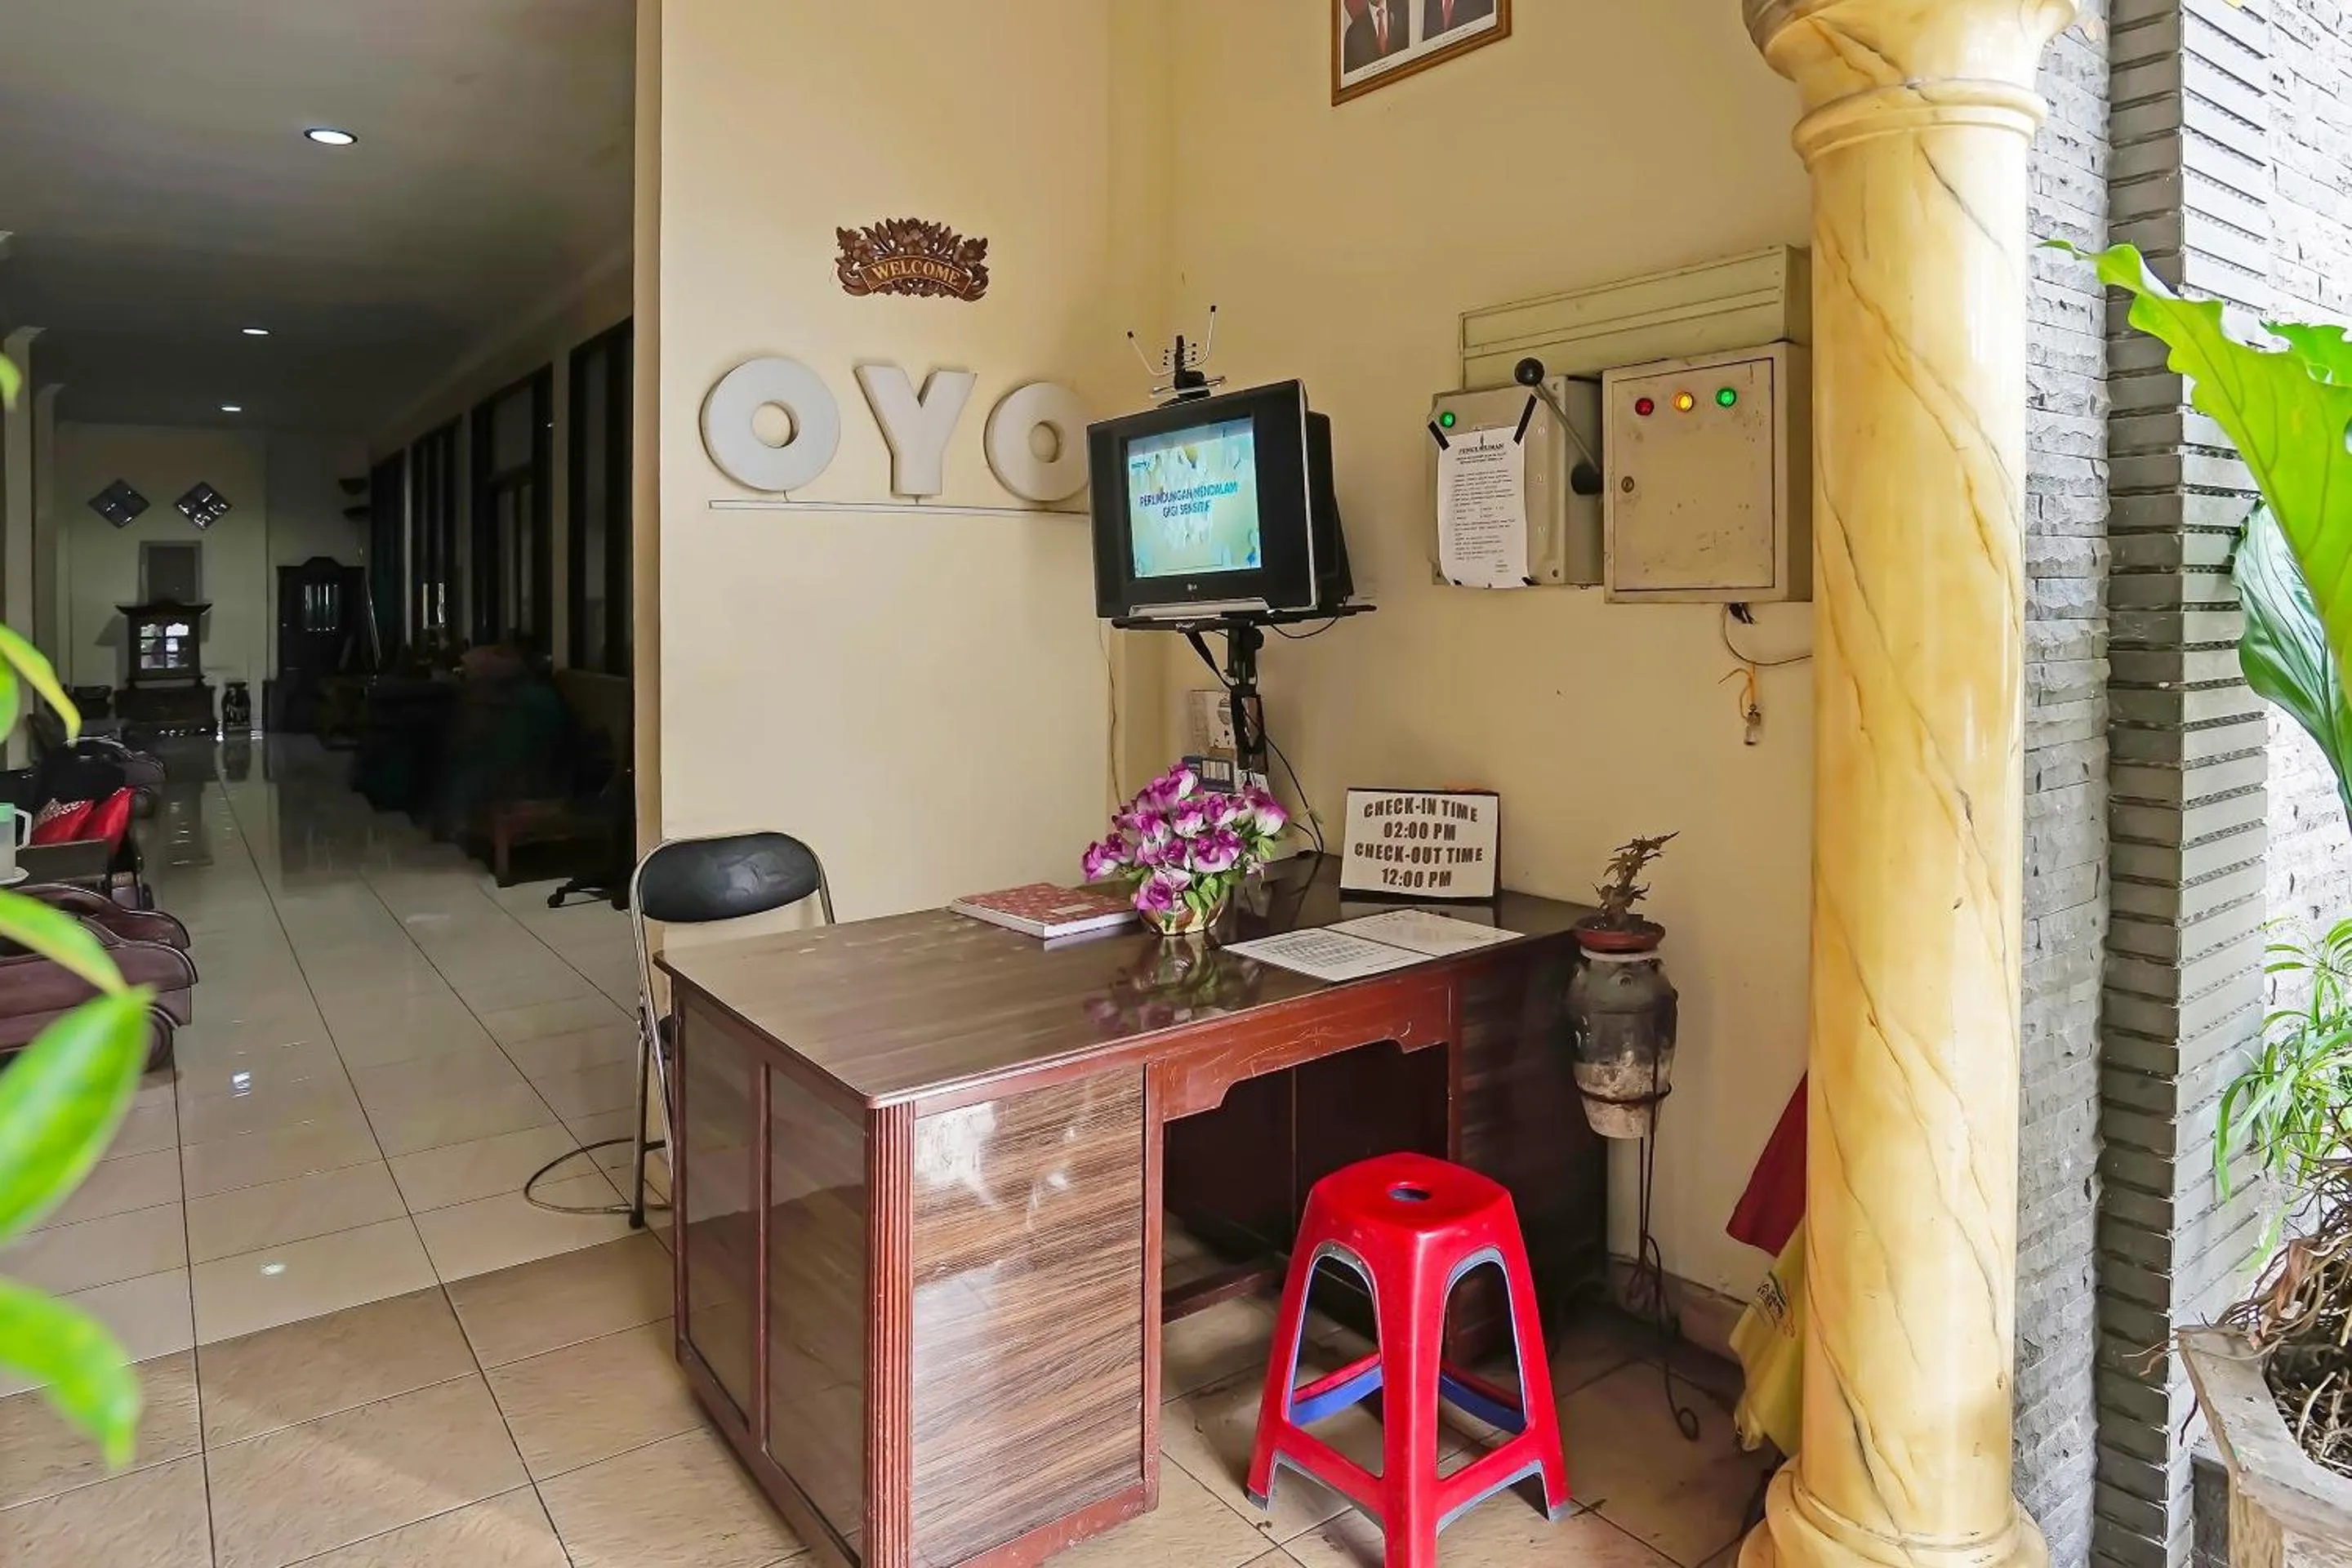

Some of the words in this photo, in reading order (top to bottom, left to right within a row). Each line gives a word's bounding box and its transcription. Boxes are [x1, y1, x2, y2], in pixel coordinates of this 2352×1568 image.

[871, 260, 960, 285] WELCOME
[699, 356, 1089, 502] OYO
[1364, 797, 1437, 817] CHECK-IN
[1441, 800, 1478, 822] TIME
[1383, 822, 1428, 840] 02:00
[1432, 822, 1456, 841] PM
[1354, 843, 1442, 865] CHECK-OUT
[1446, 847, 1483, 863] TIME
[1381, 868, 1424, 888] 12:00
[1428, 871, 1452, 889] PM
